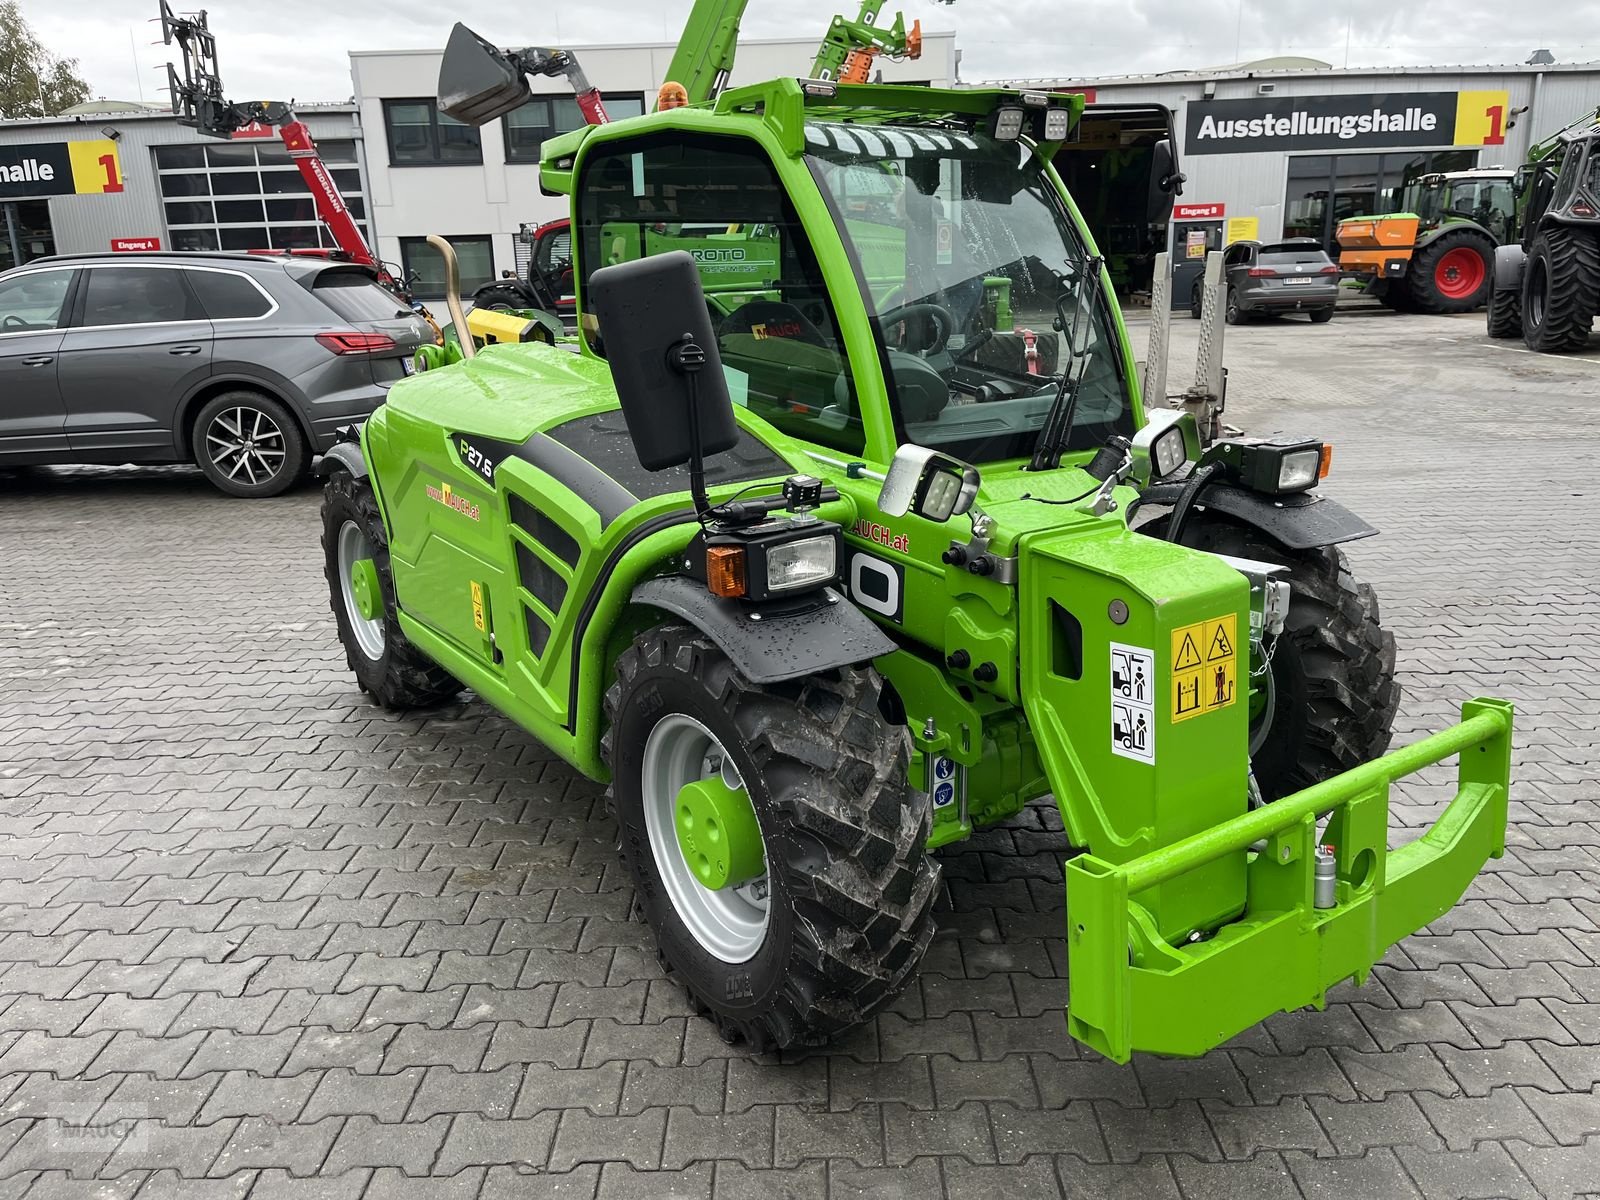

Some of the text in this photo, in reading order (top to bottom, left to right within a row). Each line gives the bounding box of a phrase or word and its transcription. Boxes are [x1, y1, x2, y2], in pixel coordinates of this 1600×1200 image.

[253, 122, 262, 131] A
[1197, 105, 1505, 145] Ausstellungshalle 1
[98, 154, 124, 193] 1
[309, 158, 342, 213] WEIDEMANN
[1180, 207, 1210, 216] Eingang
[118, 241, 154, 250] Eingang A
[690, 248, 745, 261] ROTO
[752, 322, 801, 340] MAUCH
[461, 438, 492, 478] P27.6
